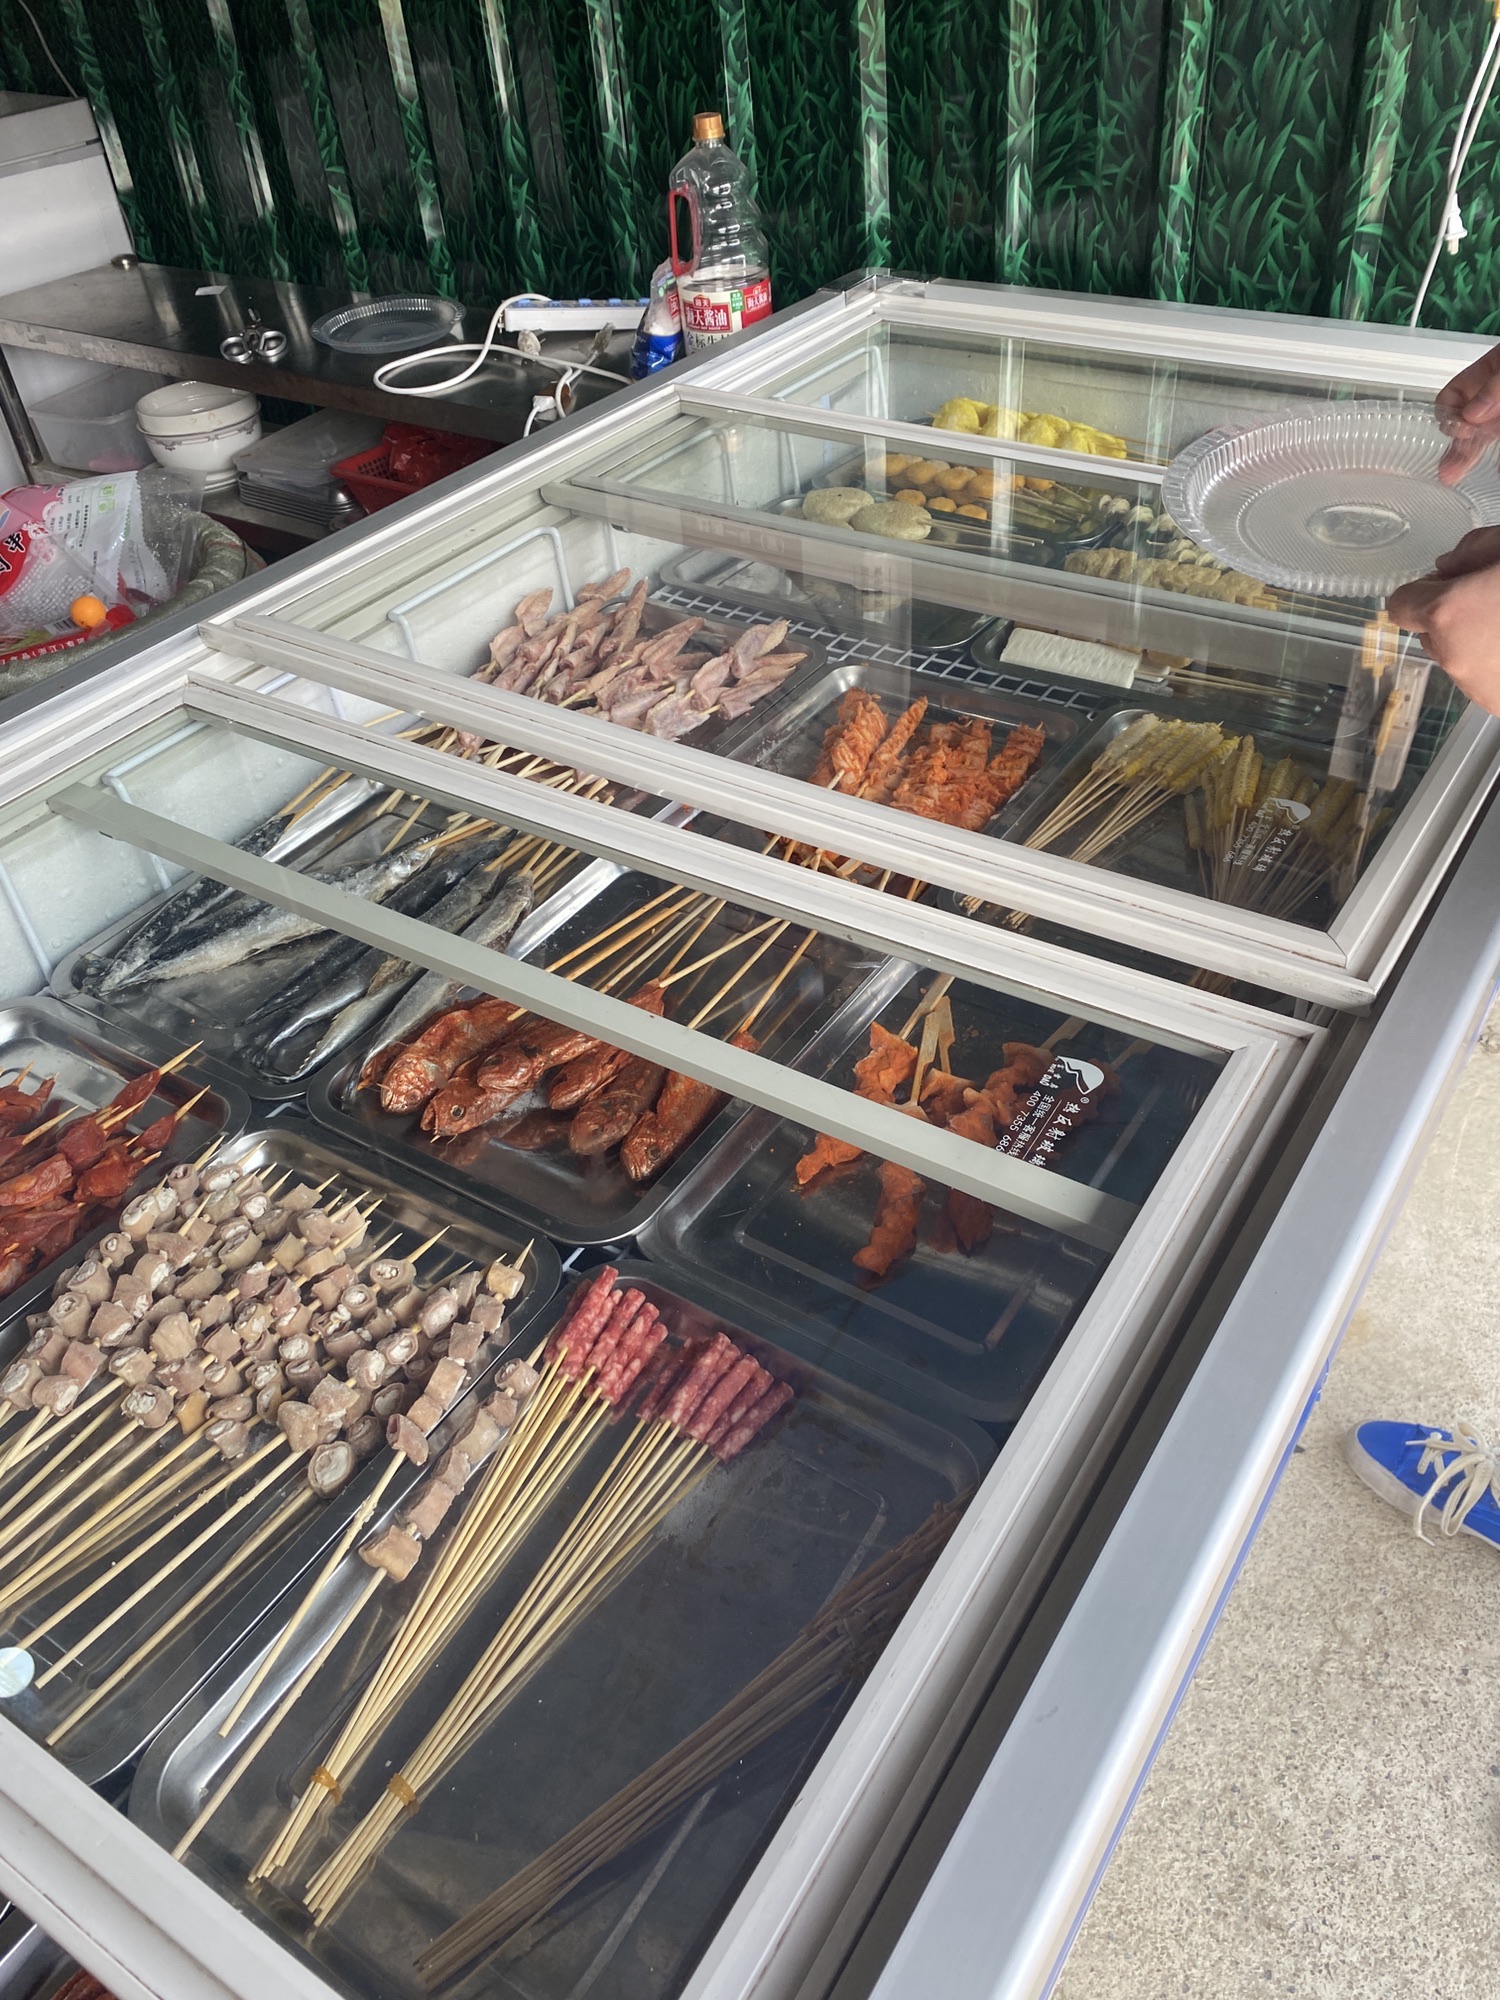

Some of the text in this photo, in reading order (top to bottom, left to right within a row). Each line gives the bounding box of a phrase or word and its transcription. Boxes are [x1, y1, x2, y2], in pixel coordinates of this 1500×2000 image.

[685, 306, 728, 327] 海天酱油
[686, 331, 730, 349] 金标生
[995, 1090, 1042, 1152] 400 7355 686
[1006, 1093, 1056, 1157] 全国统一客服热线
[1027, 1101, 1082, 1167] 热反射玻璃
